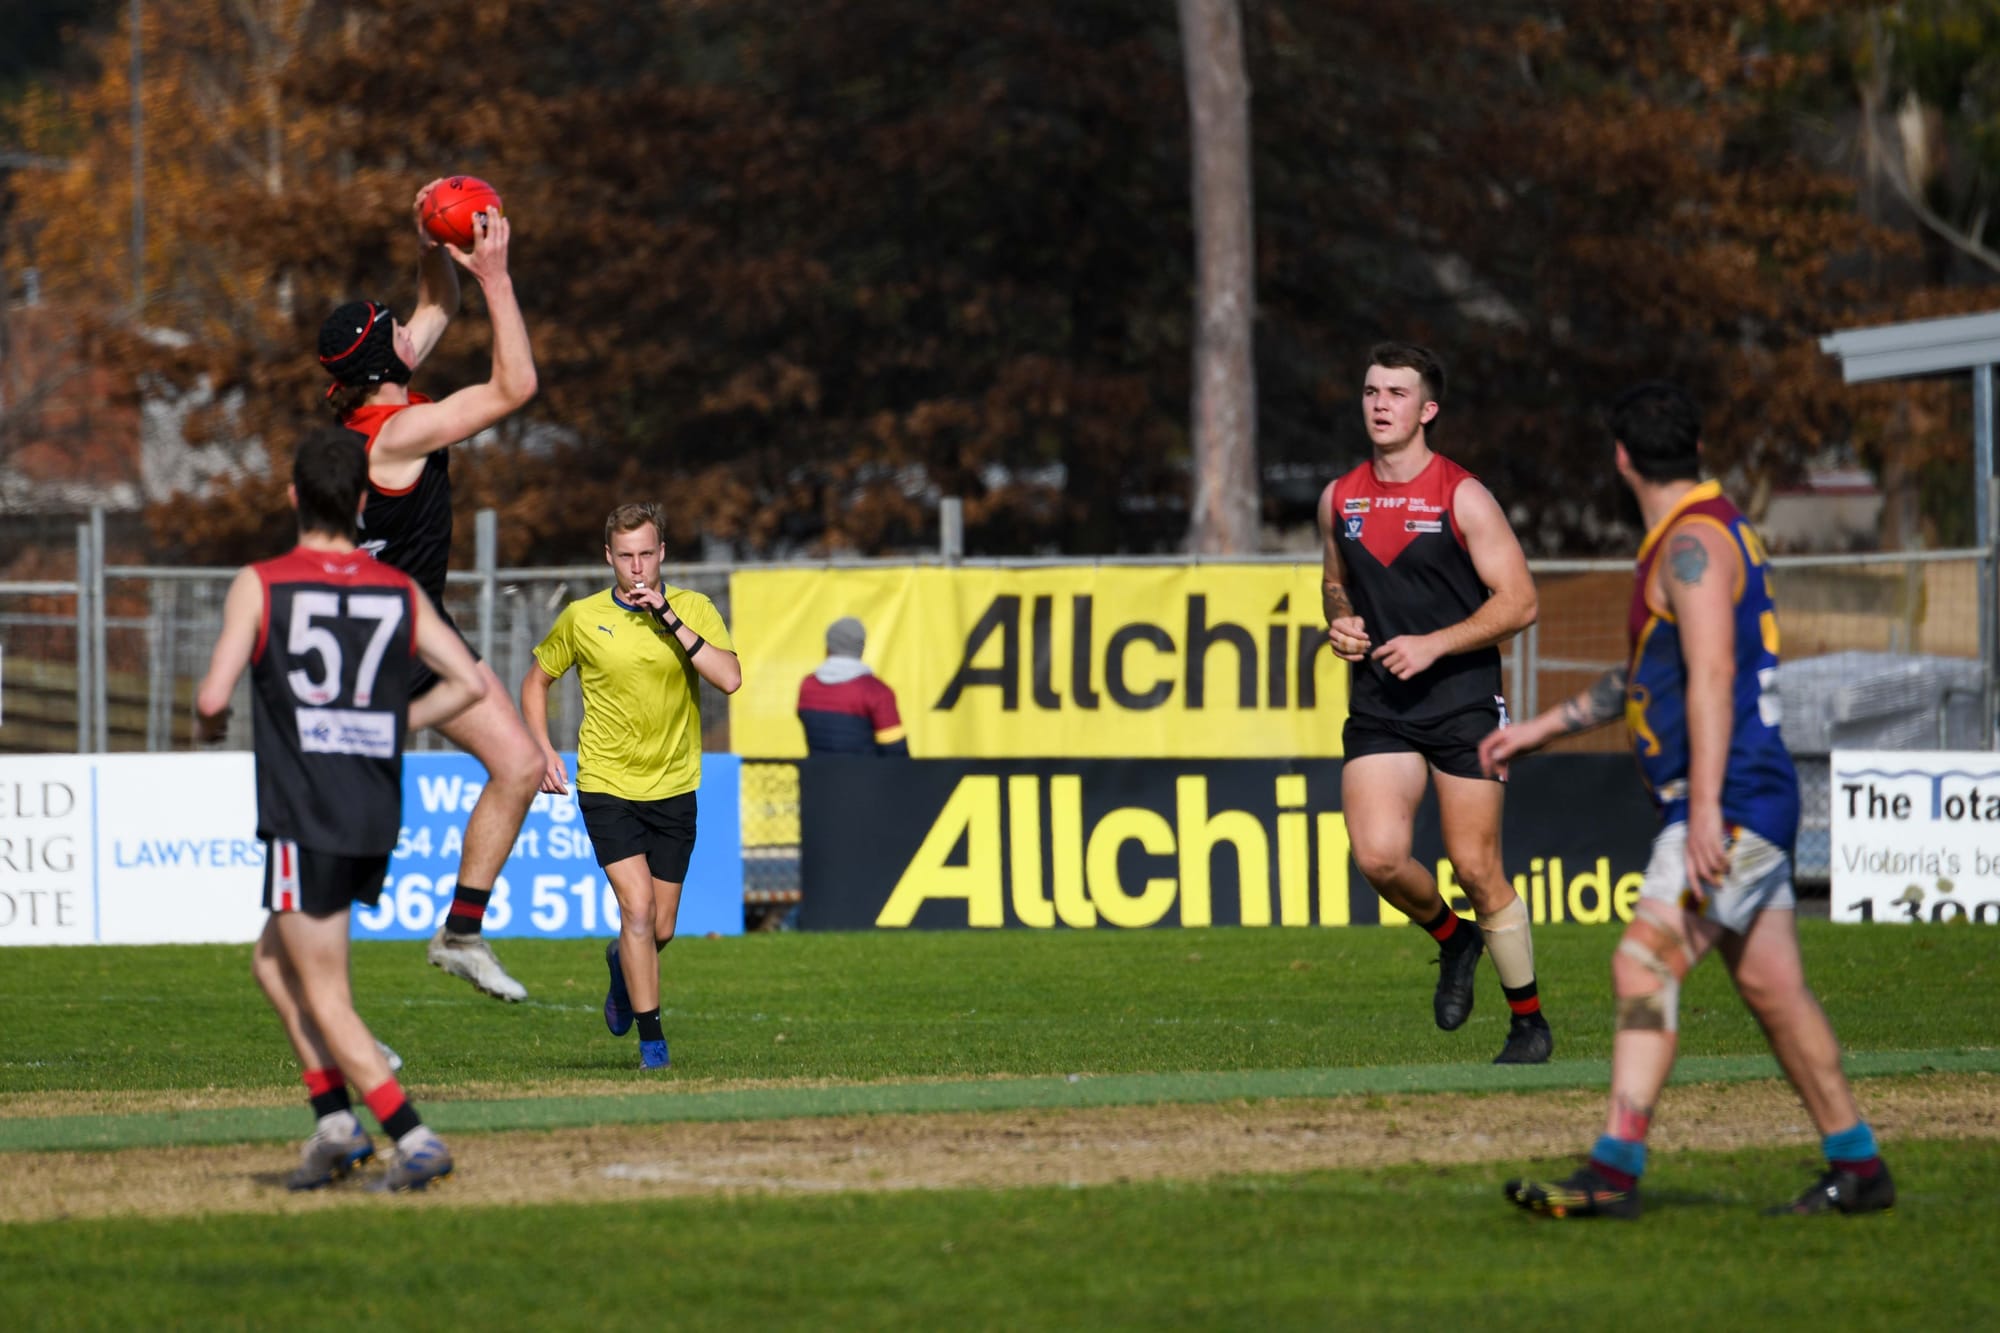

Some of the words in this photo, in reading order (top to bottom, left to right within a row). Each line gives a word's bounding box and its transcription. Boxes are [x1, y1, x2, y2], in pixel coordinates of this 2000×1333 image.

[287, 590, 403, 707] 57
[1842, 784, 1911, 820] The
[113, 840, 265, 869] LAWYERS
[1842, 844, 1961, 876] Victoria's
[1436, 855, 1645, 926] Bilde
